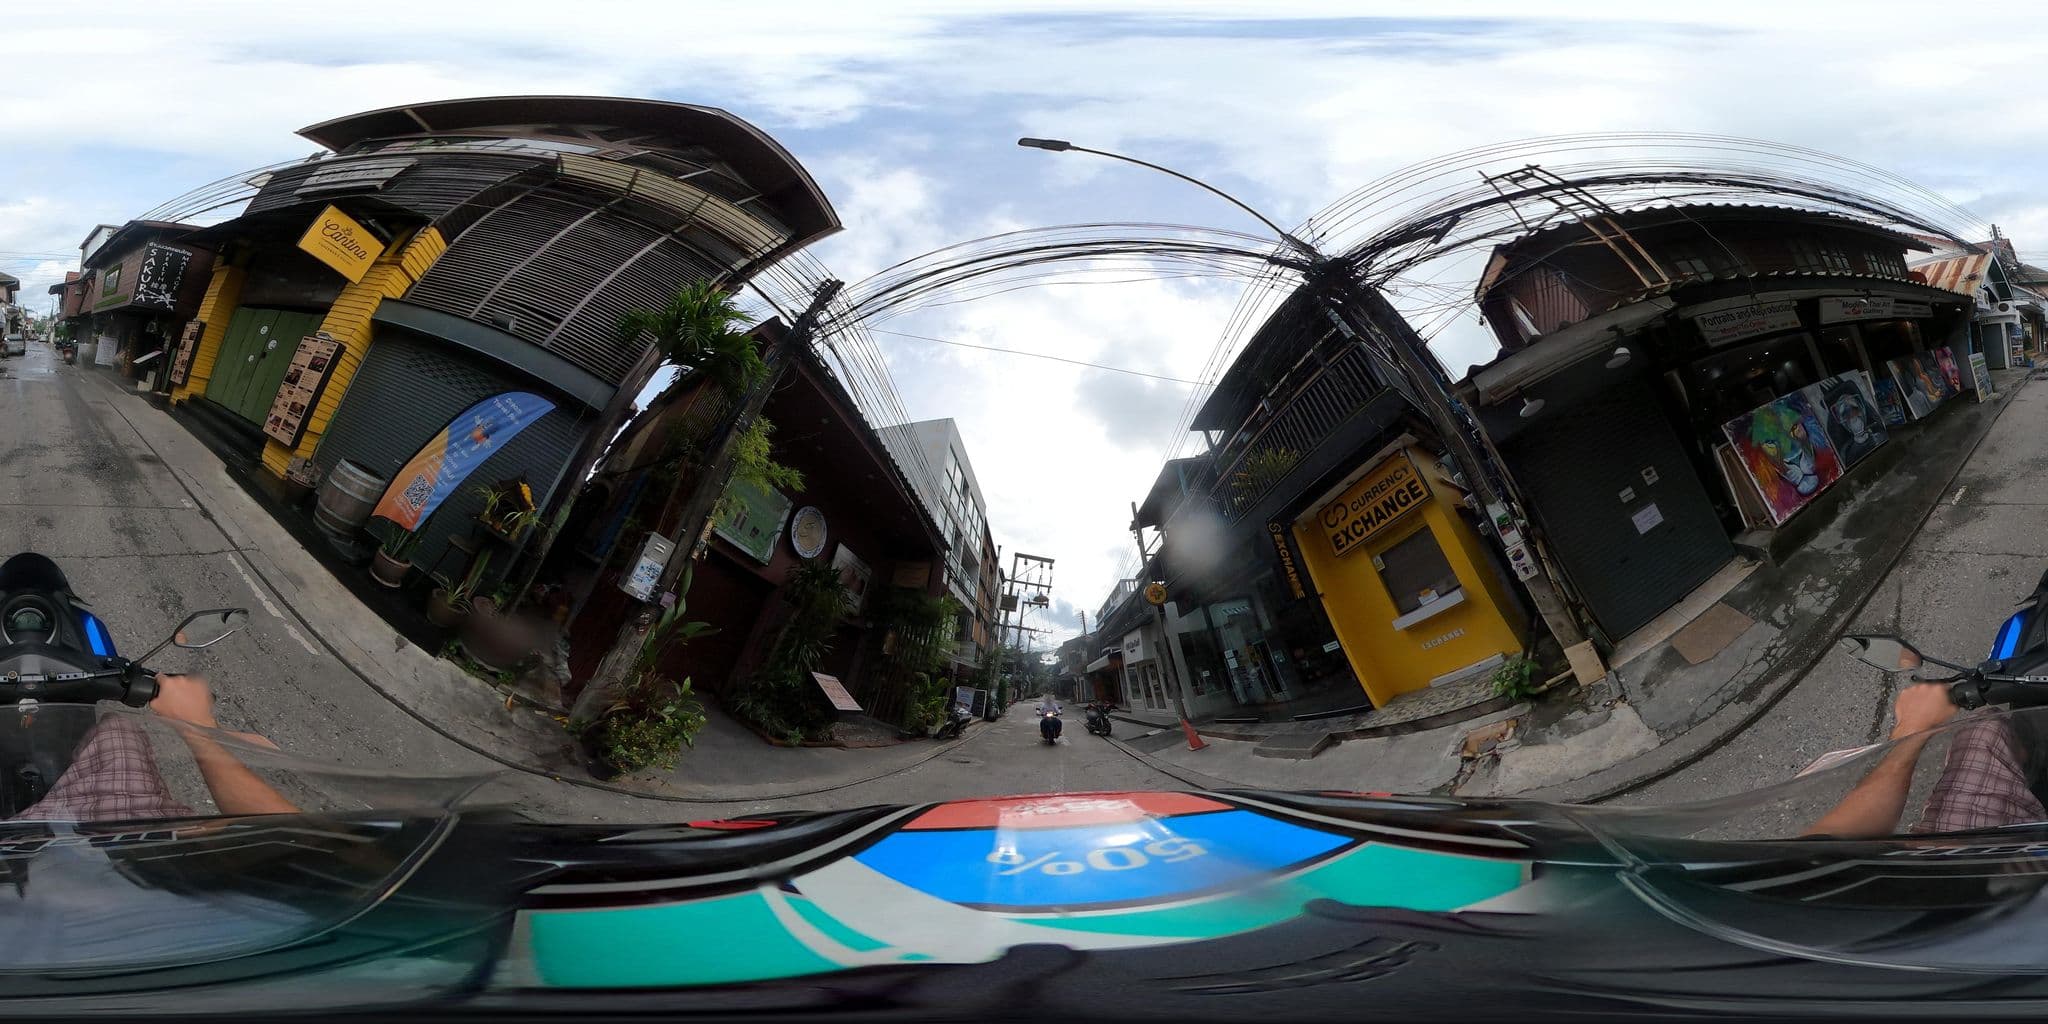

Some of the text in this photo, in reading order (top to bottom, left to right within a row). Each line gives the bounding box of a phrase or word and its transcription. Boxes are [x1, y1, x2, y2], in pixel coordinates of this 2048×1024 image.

[322, 219, 367, 260] Cantina
[135, 248, 158, 302] SAKURA
[1702, 311, 1736, 328] Portraits
[1350, 466, 1409, 512] CURRENCY
[1332, 479, 1424, 551] EXCHANGE
[1274, 534, 1306, 599] EXCHANGE
[986, 836, 1208, 876] 50%
